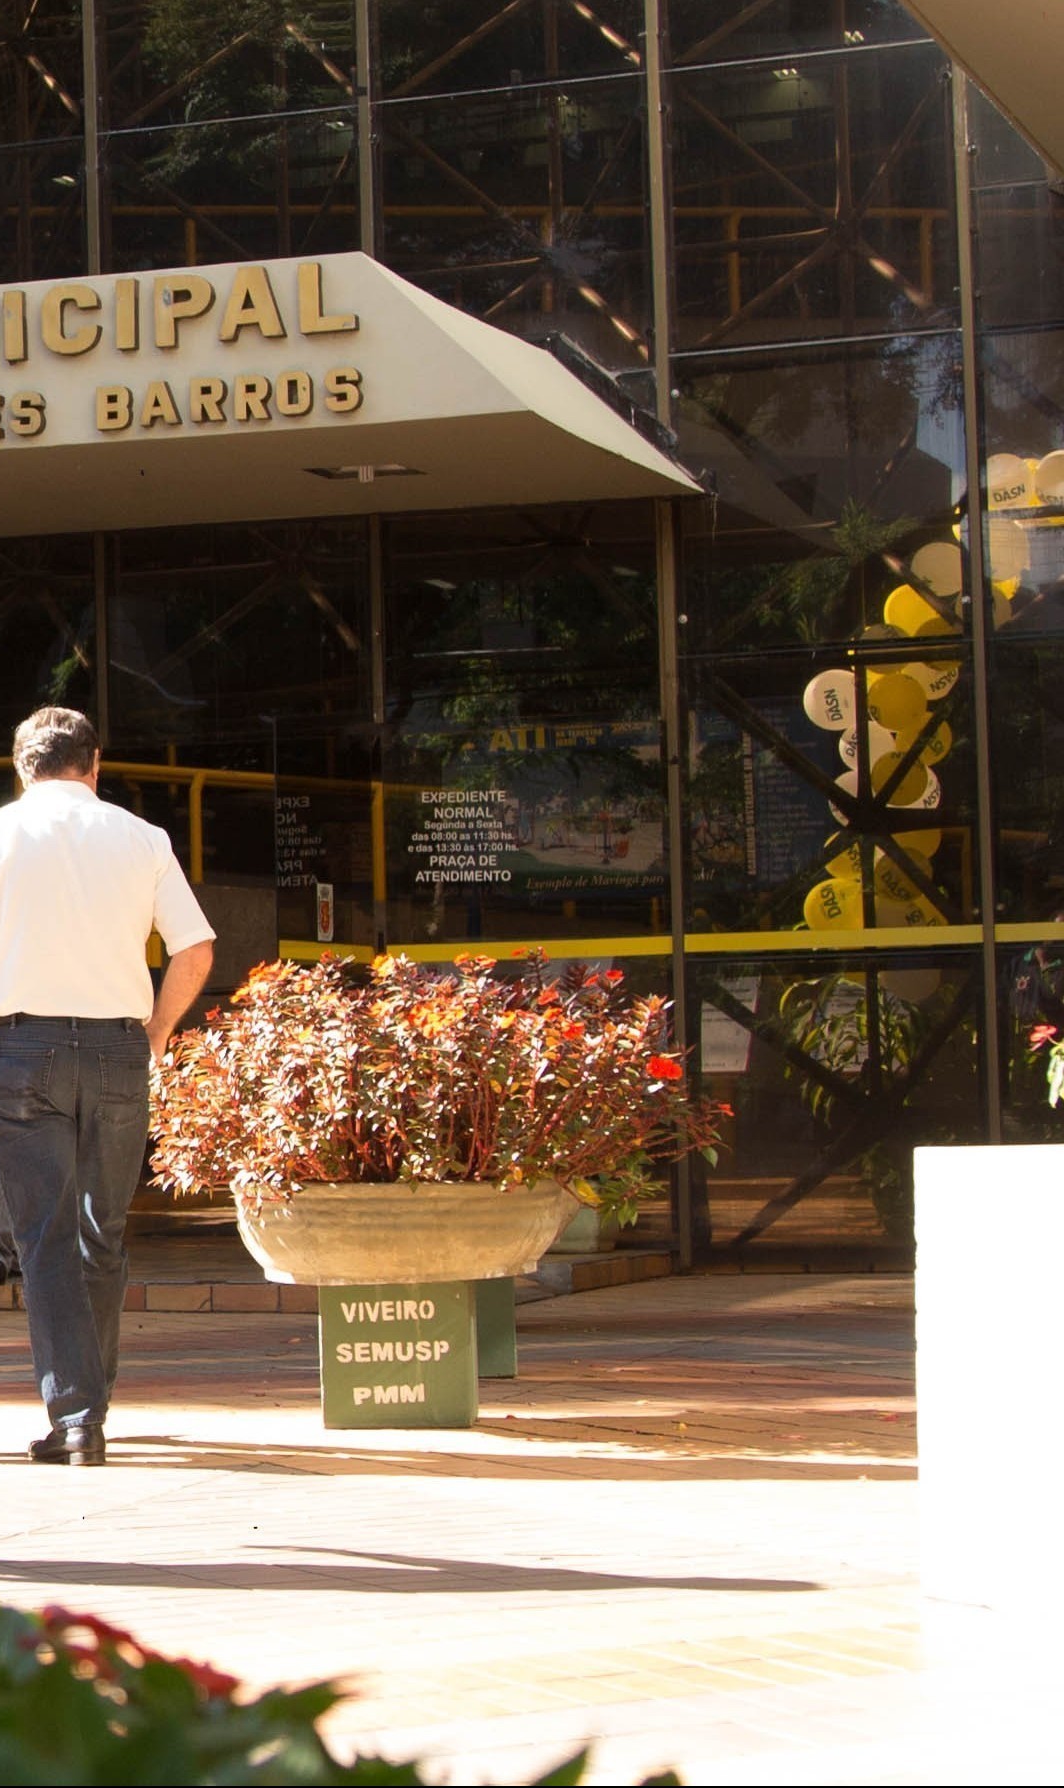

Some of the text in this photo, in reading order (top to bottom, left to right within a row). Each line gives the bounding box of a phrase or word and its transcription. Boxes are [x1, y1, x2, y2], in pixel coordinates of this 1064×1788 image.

[96, 366, 364, 434] BARROS
[993, 483, 1026, 502] DASN
[824, 688, 843, 722] DASN
[489, 724, 546, 752] ATI
[421, 790, 506, 803] EXPEDIENTE
[434, 807, 494, 819] NORMAL
[424, 820, 466, 831] Segunda
[476, 820, 503, 829] Sexta
[411, 832, 430, 841] das
[431, 832, 457, 841] 08:00
[473, 831, 499, 840] 11:30
[416, 844, 433, 853] das
[435, 843, 462, 853] 13:30
[478, 843, 503, 852] 17:00
[429, 855, 497, 868] PRAÇA DE
[415, 870, 512, 883] ATENDIMENTO
[575, 876, 588, 888] de
[340, 1300, 435, 1323] VIVEIRO
[336, 1340, 450, 1363] SEMUSP
[353, 1383, 426, 1405] PMM
